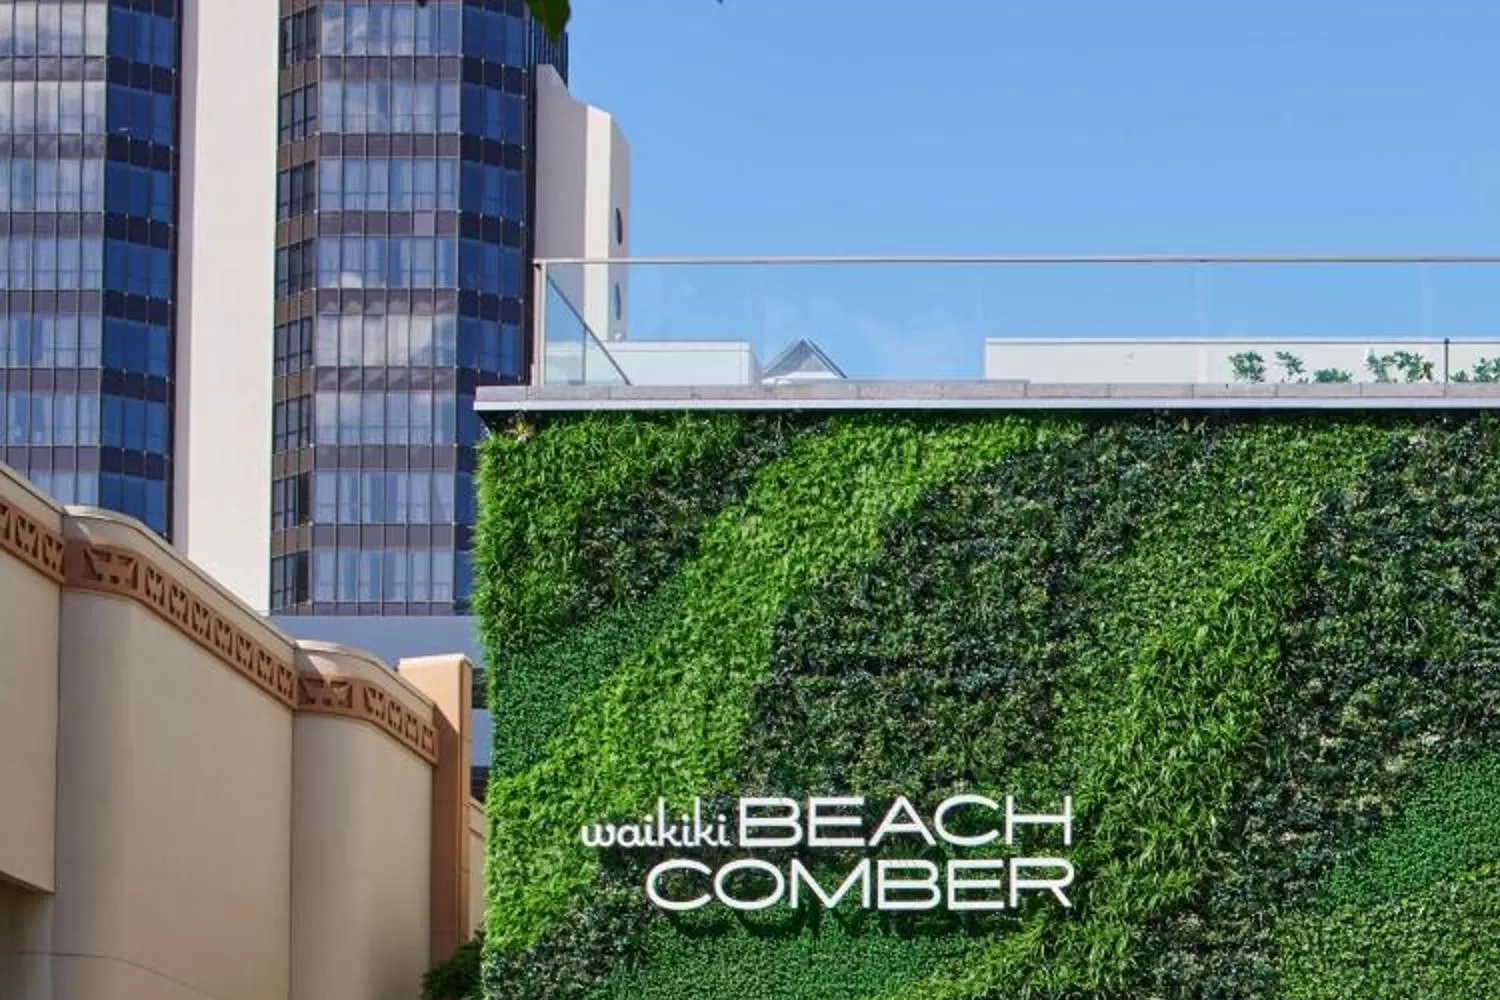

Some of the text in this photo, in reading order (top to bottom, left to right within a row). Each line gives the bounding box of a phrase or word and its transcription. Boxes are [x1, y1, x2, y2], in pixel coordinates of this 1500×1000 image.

[581, 796, 1072, 848] waikiki BEACH
[645, 858, 1075, 911] COMBER
